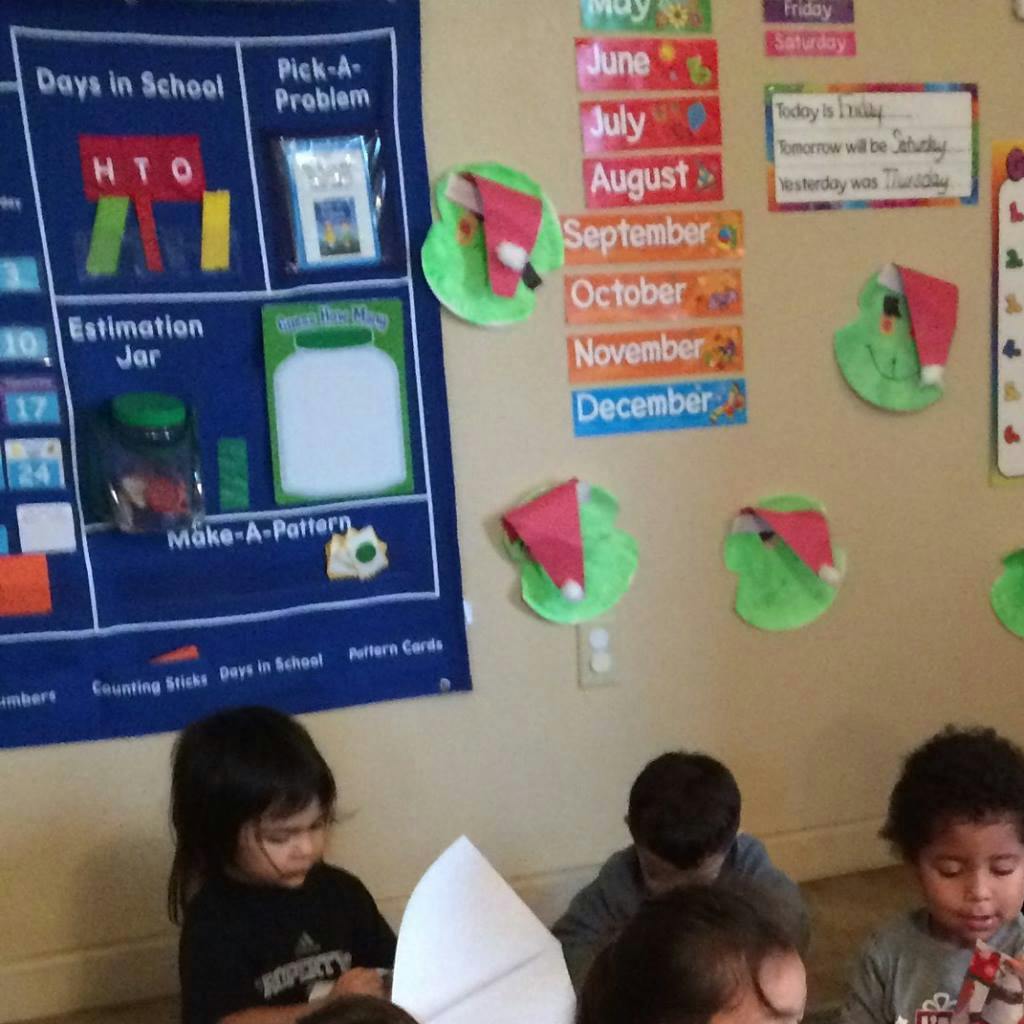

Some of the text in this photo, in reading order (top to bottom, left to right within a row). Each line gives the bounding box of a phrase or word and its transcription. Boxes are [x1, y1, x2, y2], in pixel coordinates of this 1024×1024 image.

[774, 32, 847, 54] Saturday
[278, 55, 361, 81] Pick-A-
[587, 43, 650, 76] June
[36, 67, 224, 101] Days in School
[275, 86, 370, 113] Problem
[776, 103, 819, 122] Today
[590, 104, 646, 143] July
[778, 139, 843, 155] Tomorrow
[846, 139, 866, 154] will
[870, 139, 887, 153] be
[93, 157, 193, 184] H T O
[591, 160, 689, 203] August
[778, 175, 847, 194] Yesterday
[850, 177, 878, 190] was
[563, 216, 711, 257] September
[571, 276, 687, 309] October
[68, 315, 204, 342] Estimation
[5, 330, 37, 355] 10
[574, 333, 705, 368] November
[116, 344, 161, 370] Jar
[16, 396, 47, 420] 17
[576, 386, 712, 422] December
[18, 461, 49, 487] 24
[167, 515, 352, 551] Make-A-Pattern
[349, 637, 443, 662] Pattern Cards
[220, 653, 324, 683] Days in School
[92, 673, 208, 696] Counting Sticks
